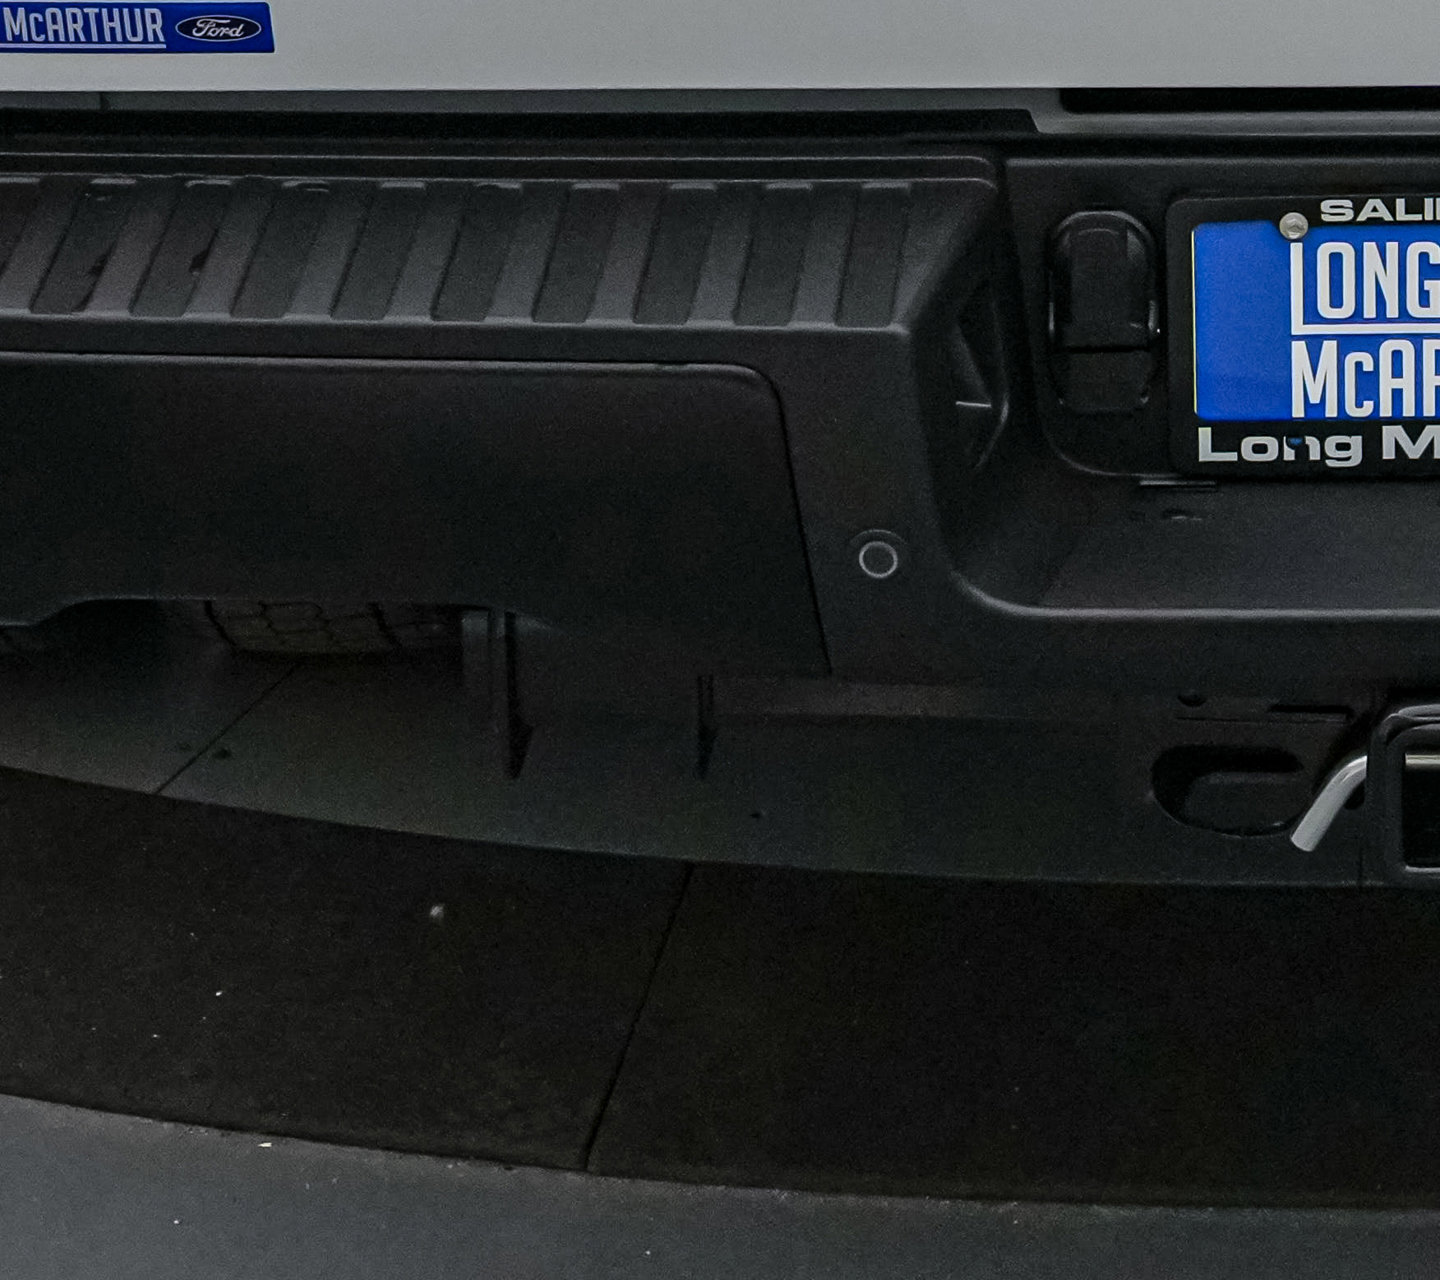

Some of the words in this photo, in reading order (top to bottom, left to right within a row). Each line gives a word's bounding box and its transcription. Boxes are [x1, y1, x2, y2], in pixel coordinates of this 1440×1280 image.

[3, 6, 166, 42] McARTHUR
[191, 17, 246, 39] Ford
[1198, 425, 1363, 468] Long
